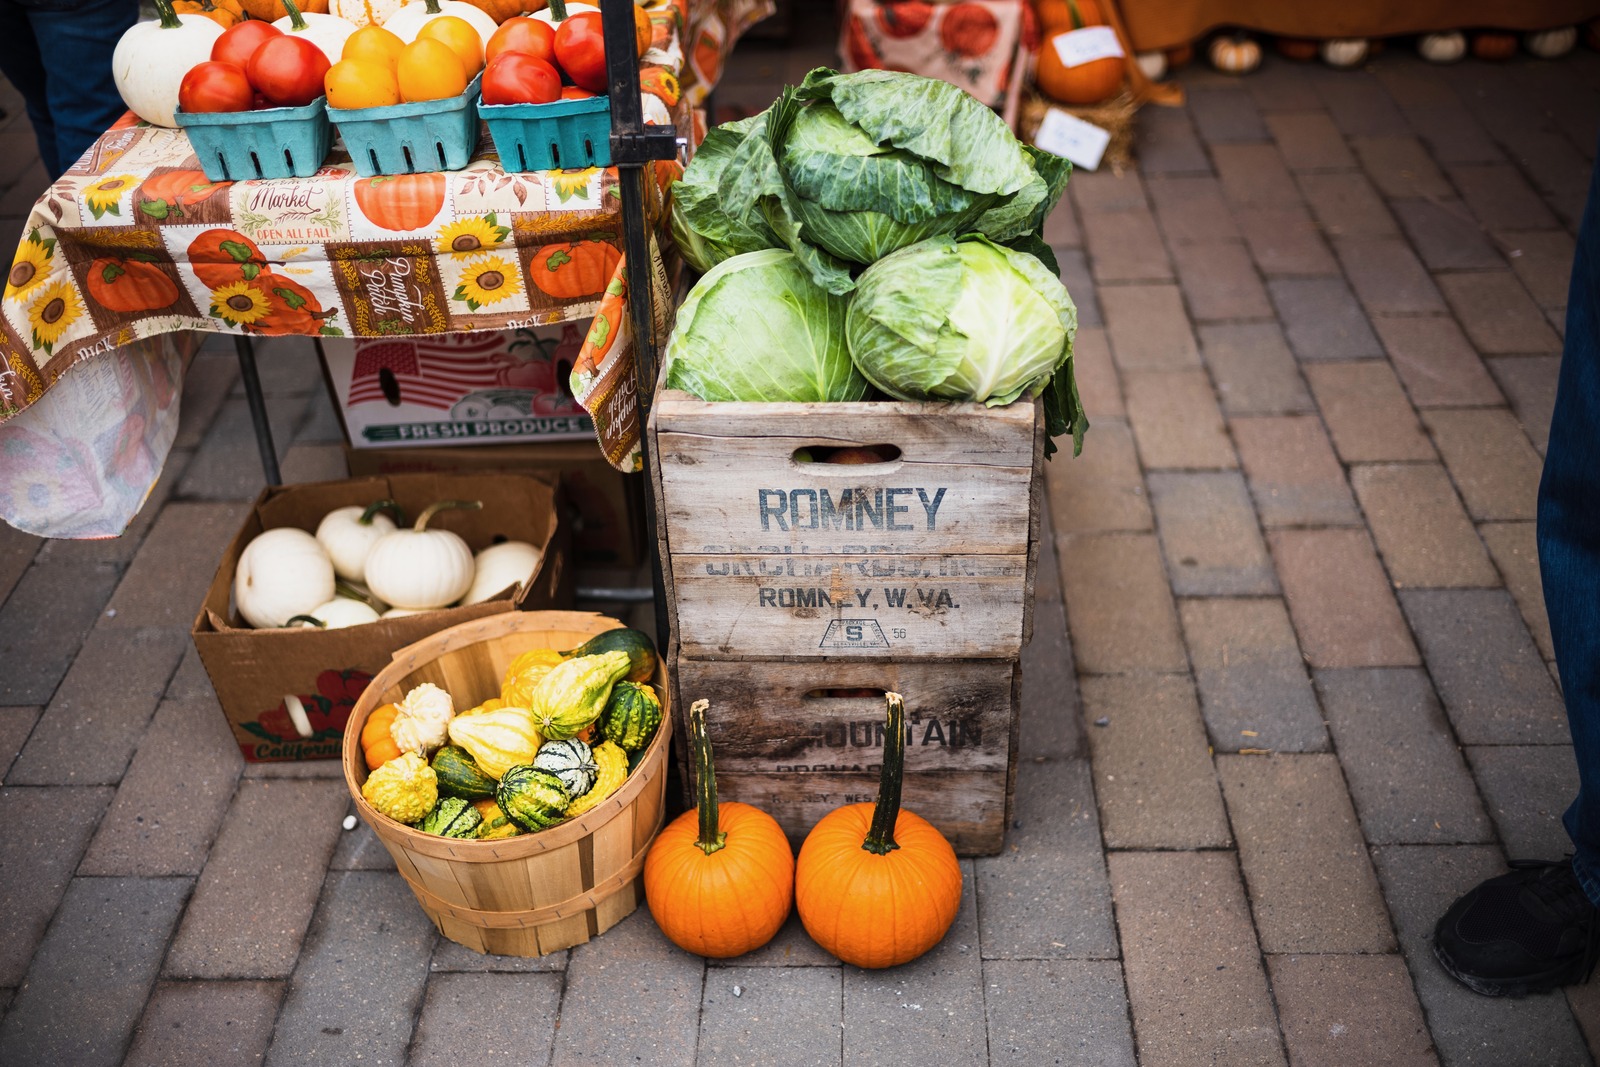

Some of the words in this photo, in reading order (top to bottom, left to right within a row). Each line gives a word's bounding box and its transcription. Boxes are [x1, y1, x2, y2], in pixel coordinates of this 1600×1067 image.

[250, 185, 323, 212] Market
[257, 230, 283, 240] OPEN
[286, 229, 304, 239] ALL
[307, 228, 331, 238] FALL
[385, 257, 425, 324] Pumpkin
[398, 422, 468, 440] FRESH
[475, 417, 581, 436] PRODUCE
[758, 488, 948, 533] ROMNEY
[846, 625, 863, 641] S
[891, 628, 907, 639] '56
[256, 741, 343, 760] Californi
